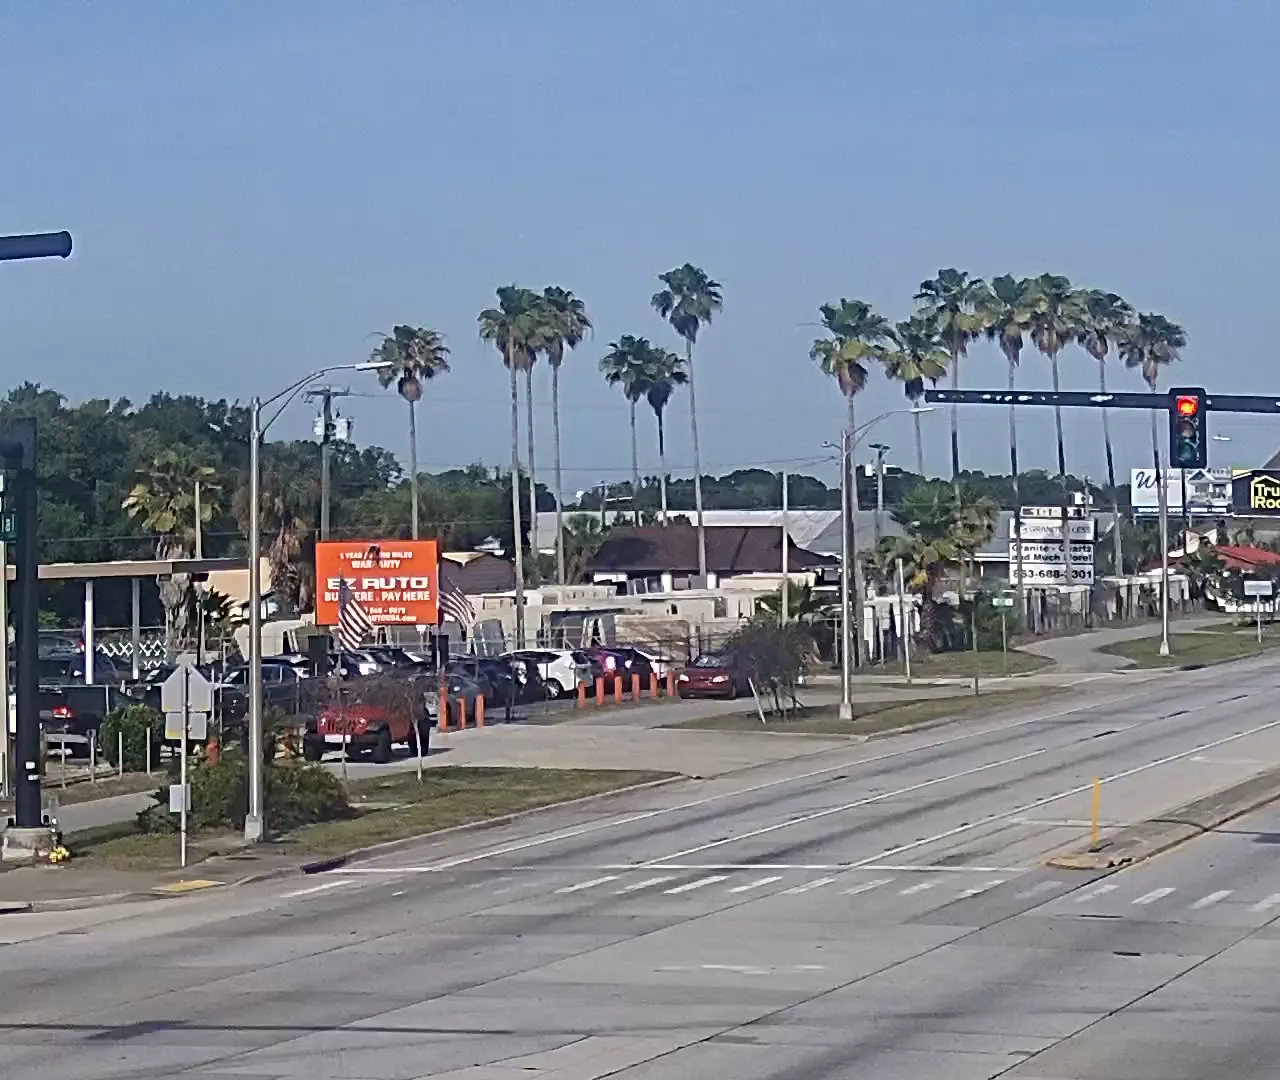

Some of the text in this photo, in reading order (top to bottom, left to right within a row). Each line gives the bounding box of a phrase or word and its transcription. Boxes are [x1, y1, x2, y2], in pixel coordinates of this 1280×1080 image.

[327, 577, 429, 590] EZ AUTO
[381, 592, 401, 601] PAY
[402, 591, 431, 601] HERE
